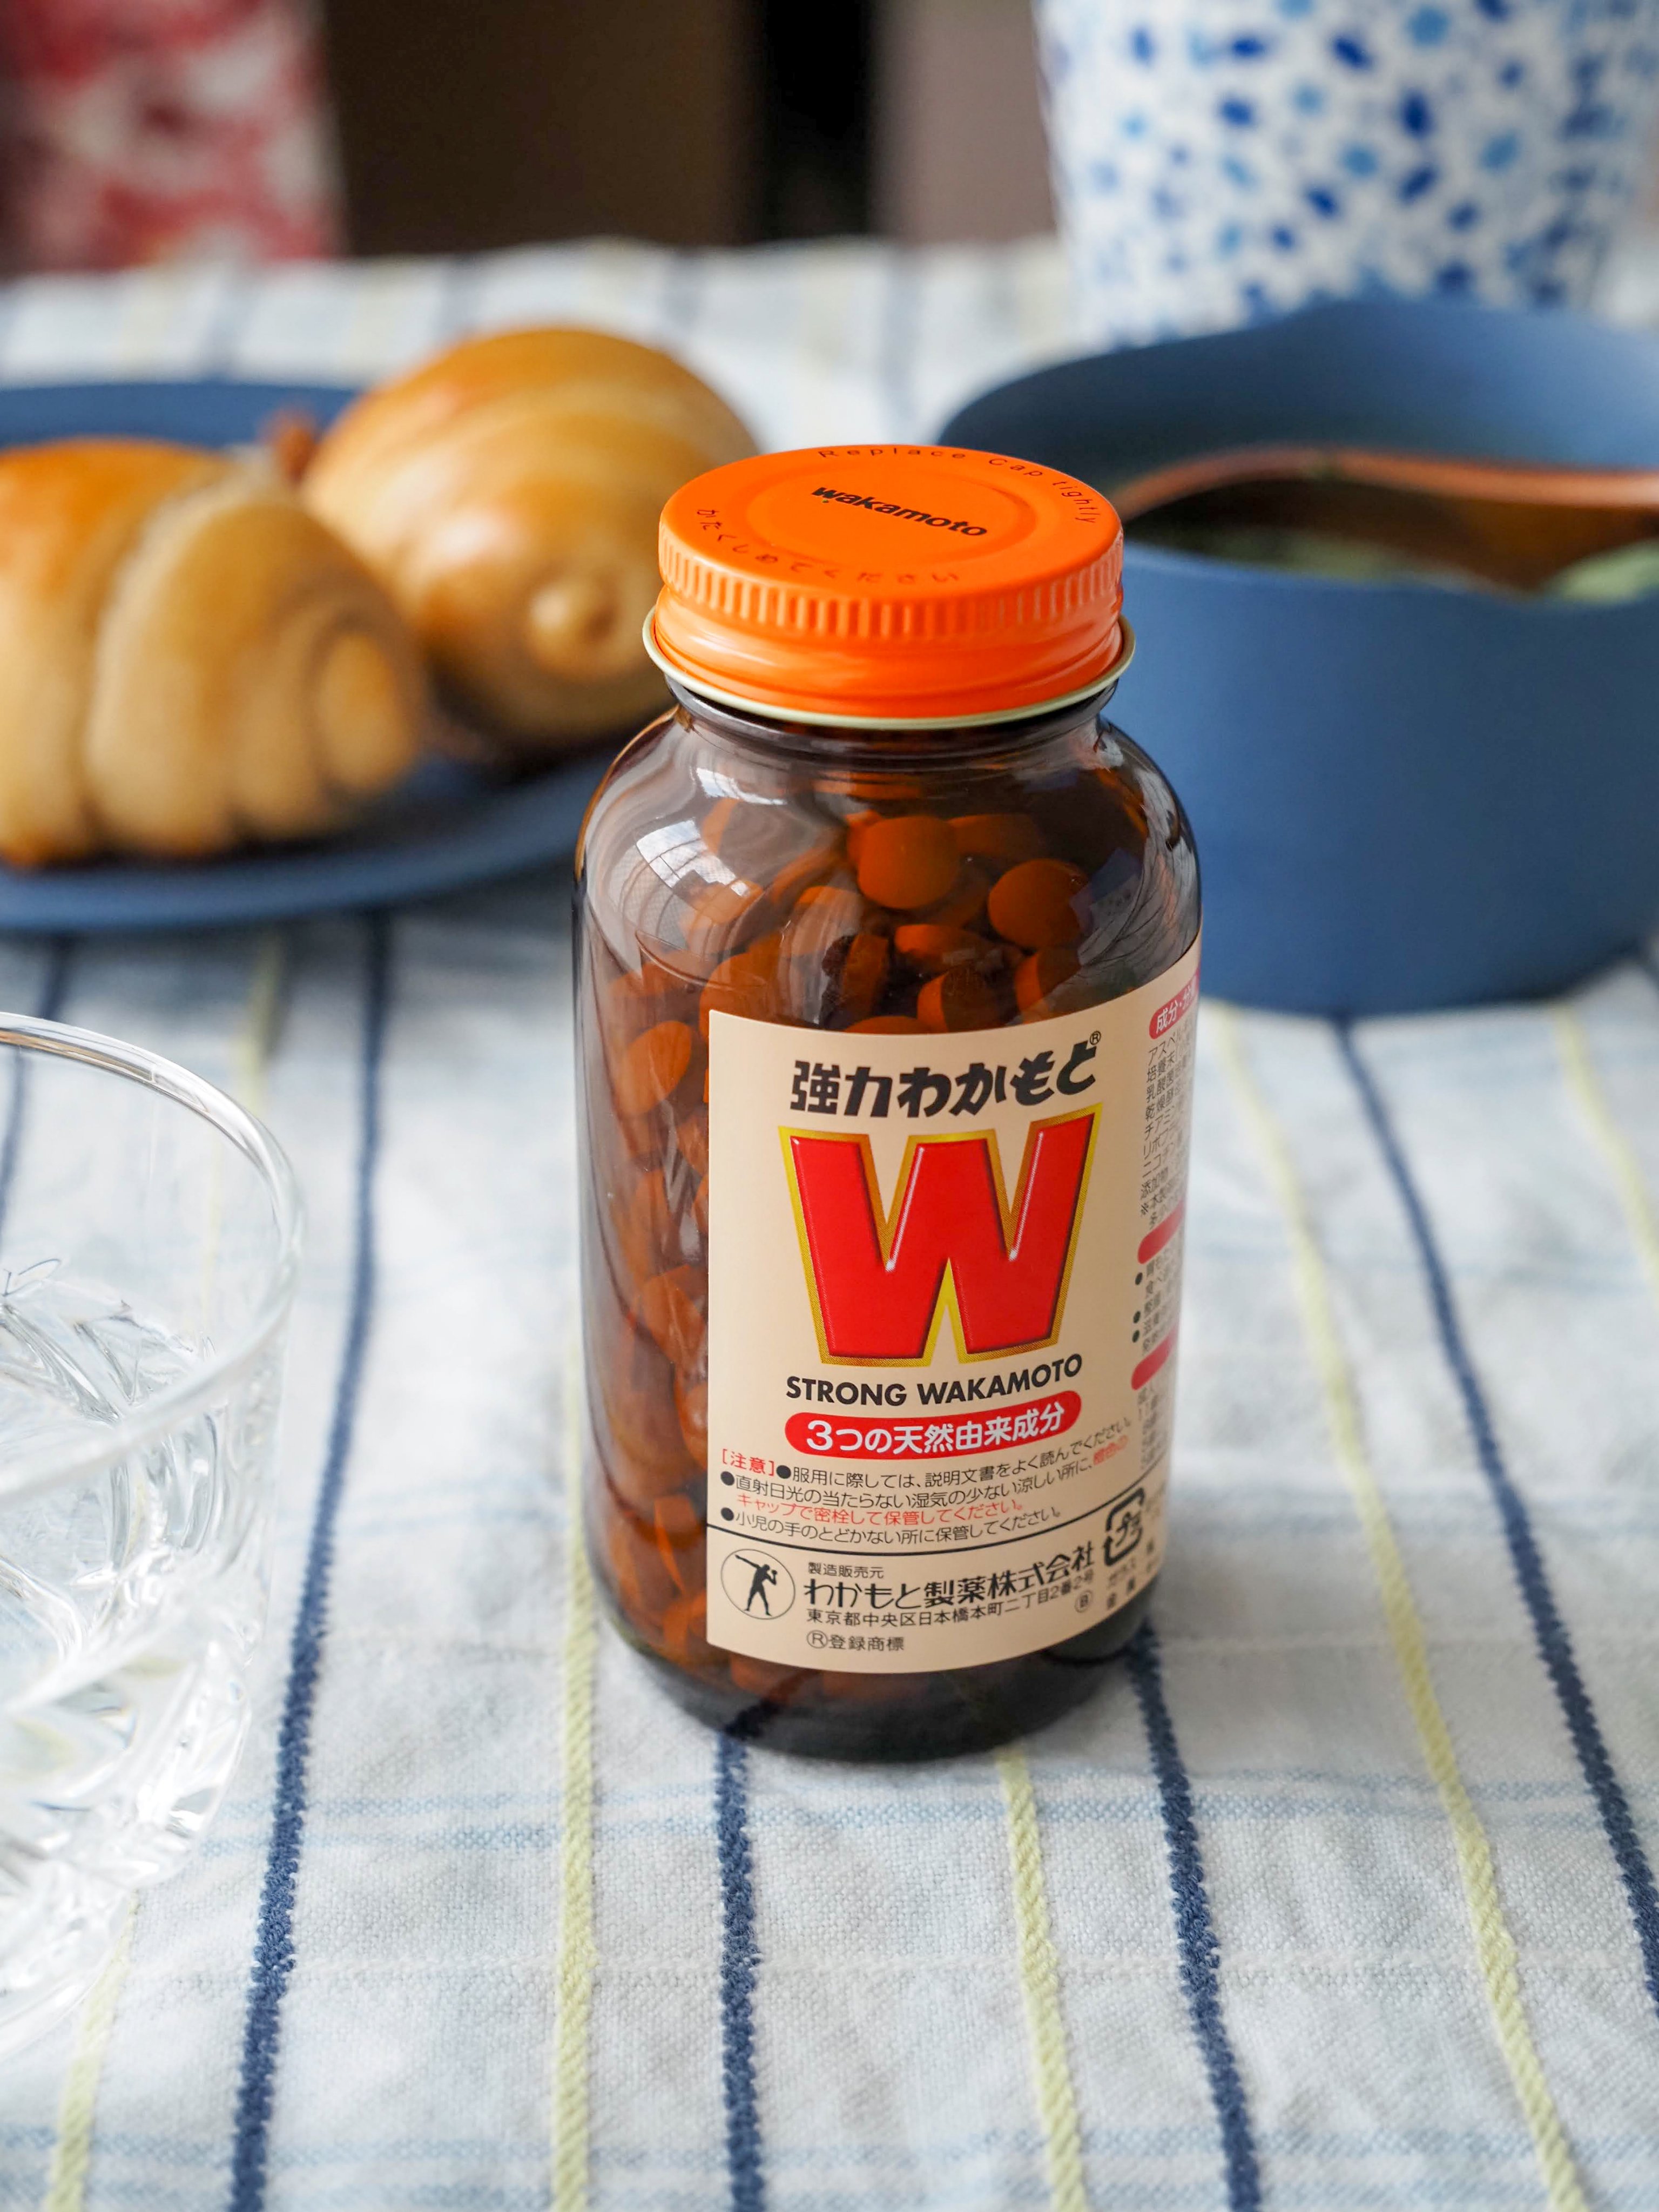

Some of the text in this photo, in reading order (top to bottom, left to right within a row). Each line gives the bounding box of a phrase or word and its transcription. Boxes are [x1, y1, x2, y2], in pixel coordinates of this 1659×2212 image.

[811, 487, 987, 536] wakamoto
[818, 448, 1101, 523] Replace Cap tightly
[697, 509, 959, 584] かたくしめてください
[778, 1103, 1102, 1366] W
[786, 1352, 1083, 1405] STRONG WAKAMOTO
[806, 1401, 1065, 1454] 3つの天然由来成分
[804, 1540, 1095, 1609] わかもと製薬株式会社
[808, 1562, 884, 1579] 製造販売元
